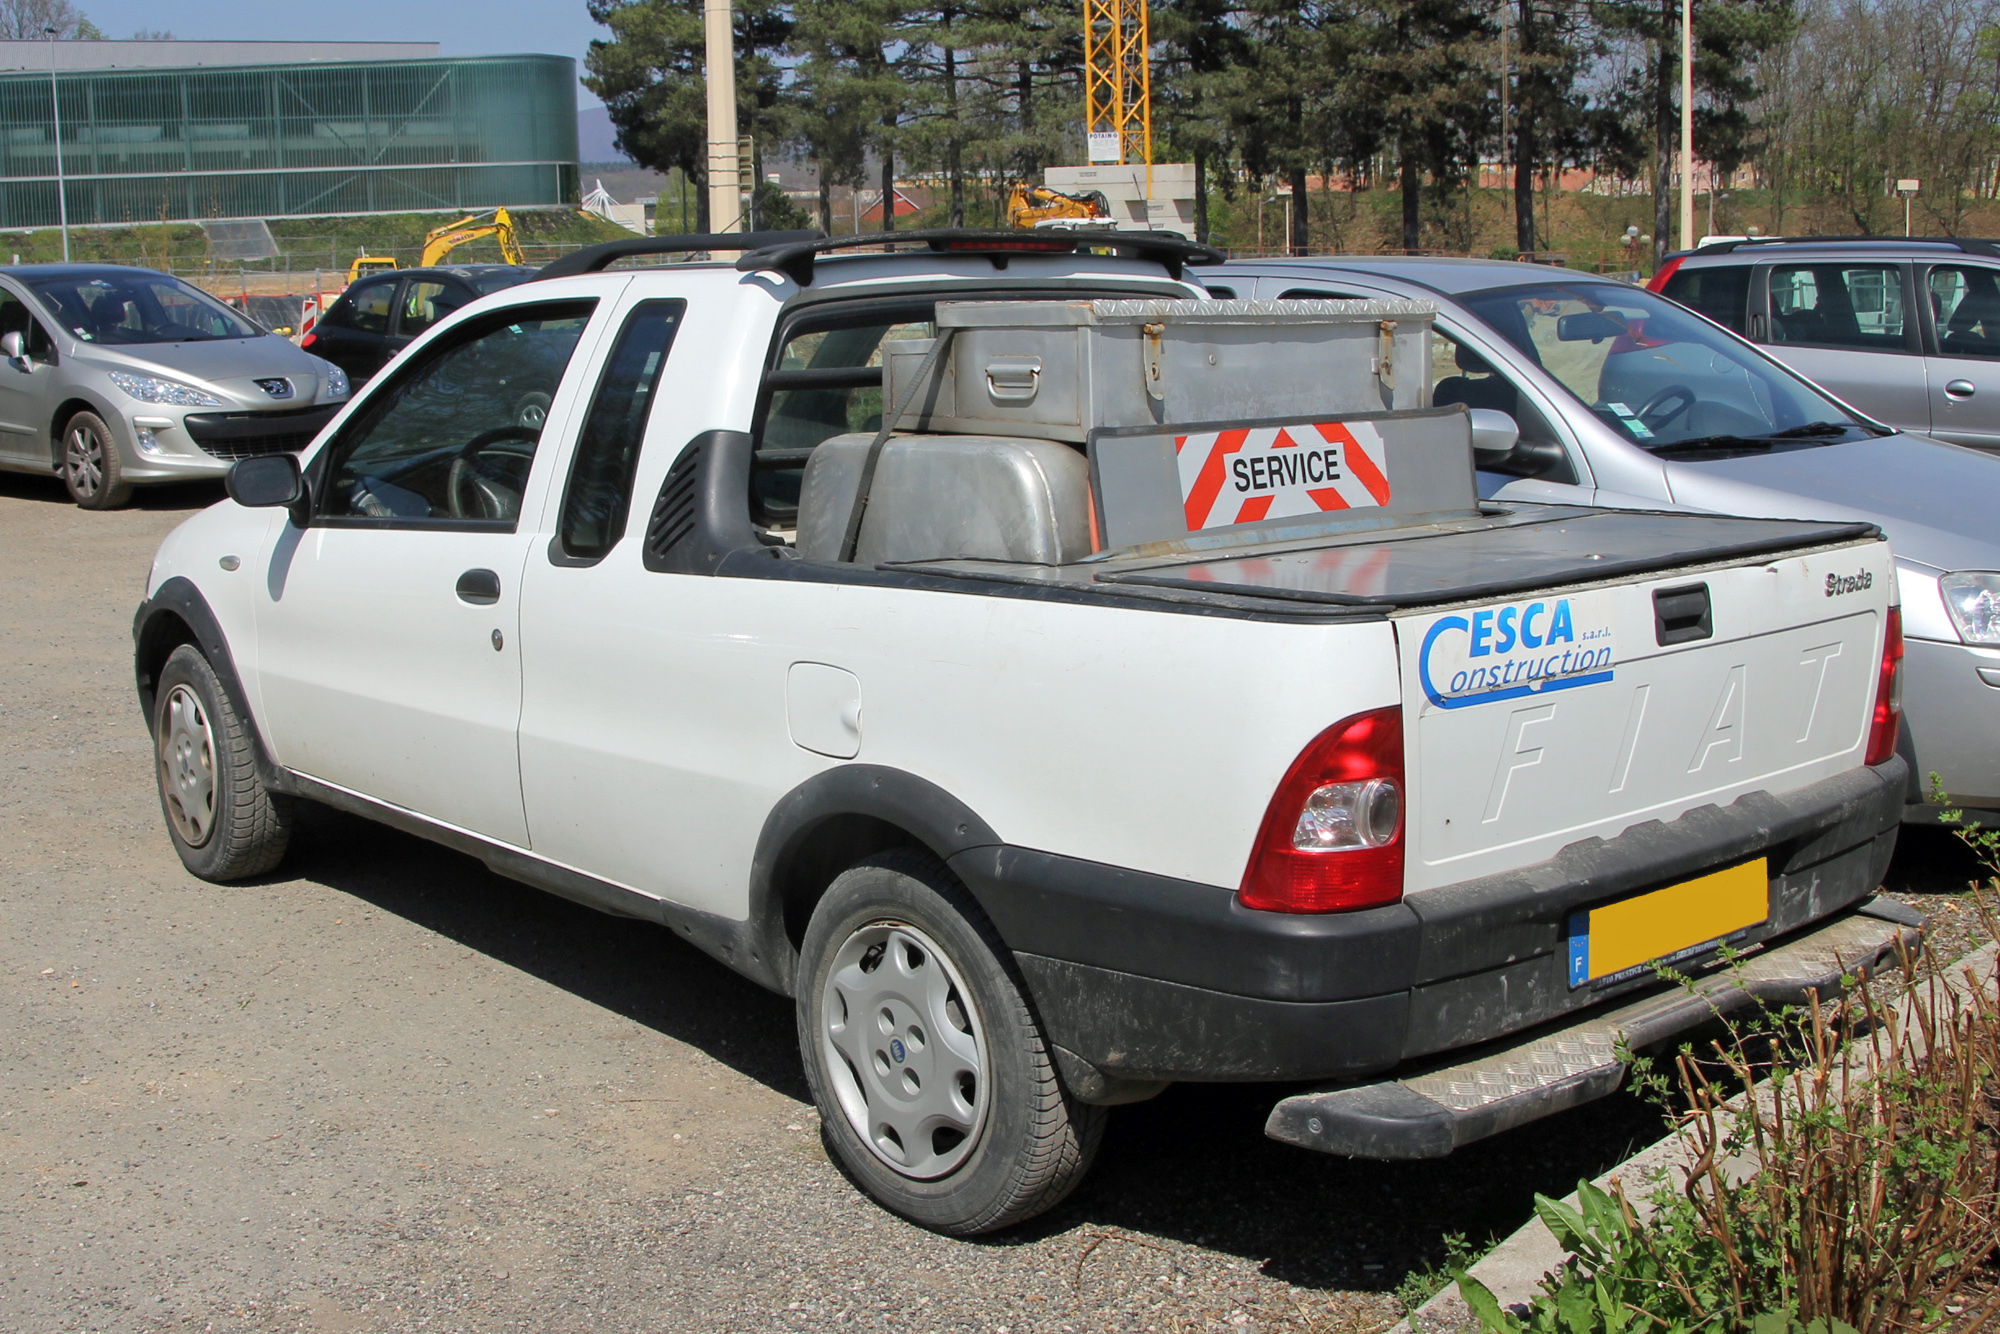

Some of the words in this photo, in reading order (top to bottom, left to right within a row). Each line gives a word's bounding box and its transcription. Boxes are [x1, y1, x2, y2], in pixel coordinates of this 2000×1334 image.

[1233, 449, 1341, 492] SERVICE
[1825, 567, 1872, 597] Strada
[1419, 599, 1574, 700] CESCA
[1481, 641, 1844, 824] FIAT
[1575, 956, 1583, 973] F
